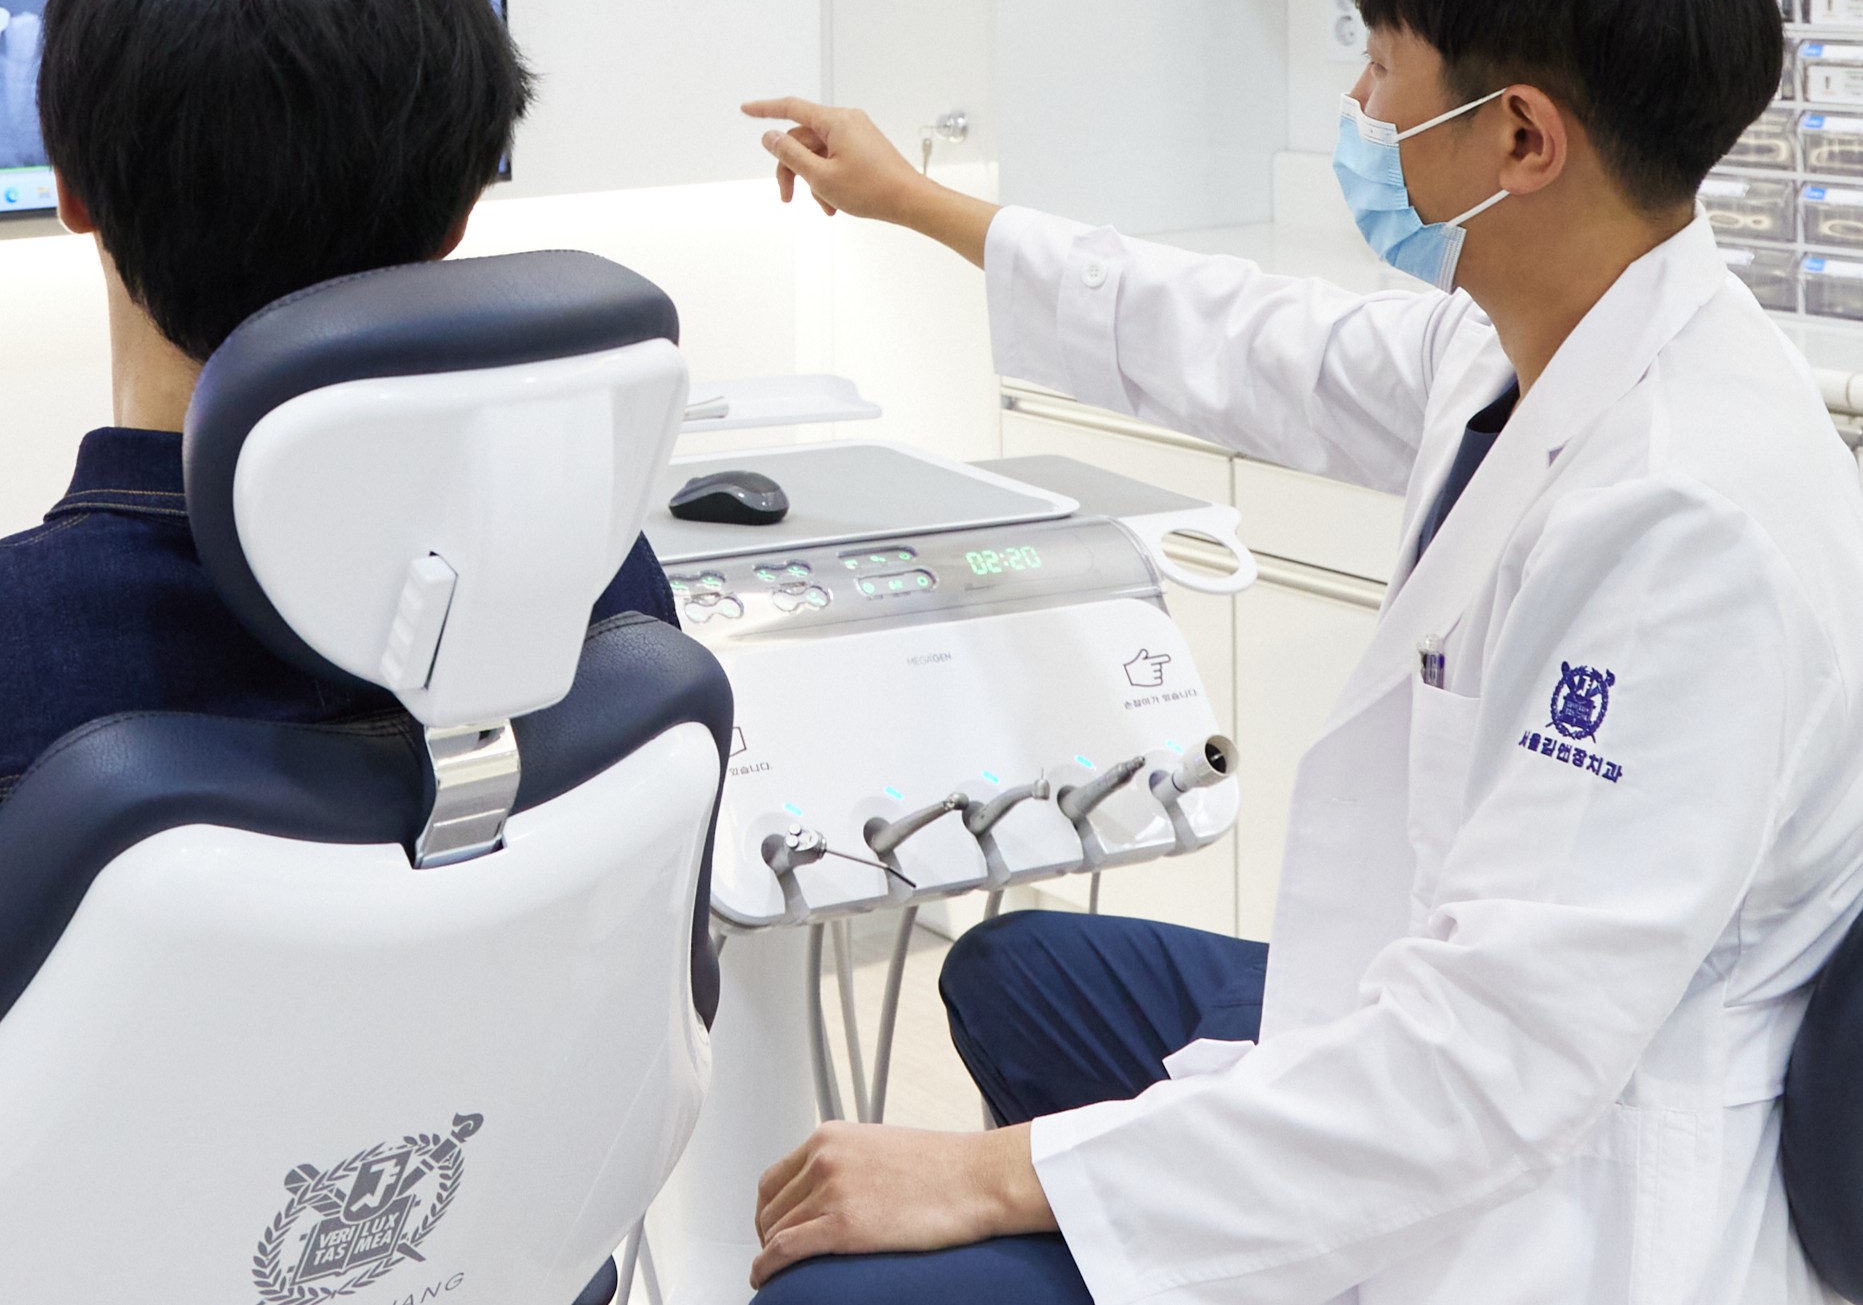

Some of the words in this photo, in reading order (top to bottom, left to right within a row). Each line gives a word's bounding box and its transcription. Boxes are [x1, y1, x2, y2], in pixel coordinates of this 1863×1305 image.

[965, 546, 1042, 576] 02:20
[320, 1225, 356, 1249] VERI
[361, 1211, 399, 1237] LUX
[313, 1243, 348, 1266] TAS
[353, 1229, 393, 1255] MEA
